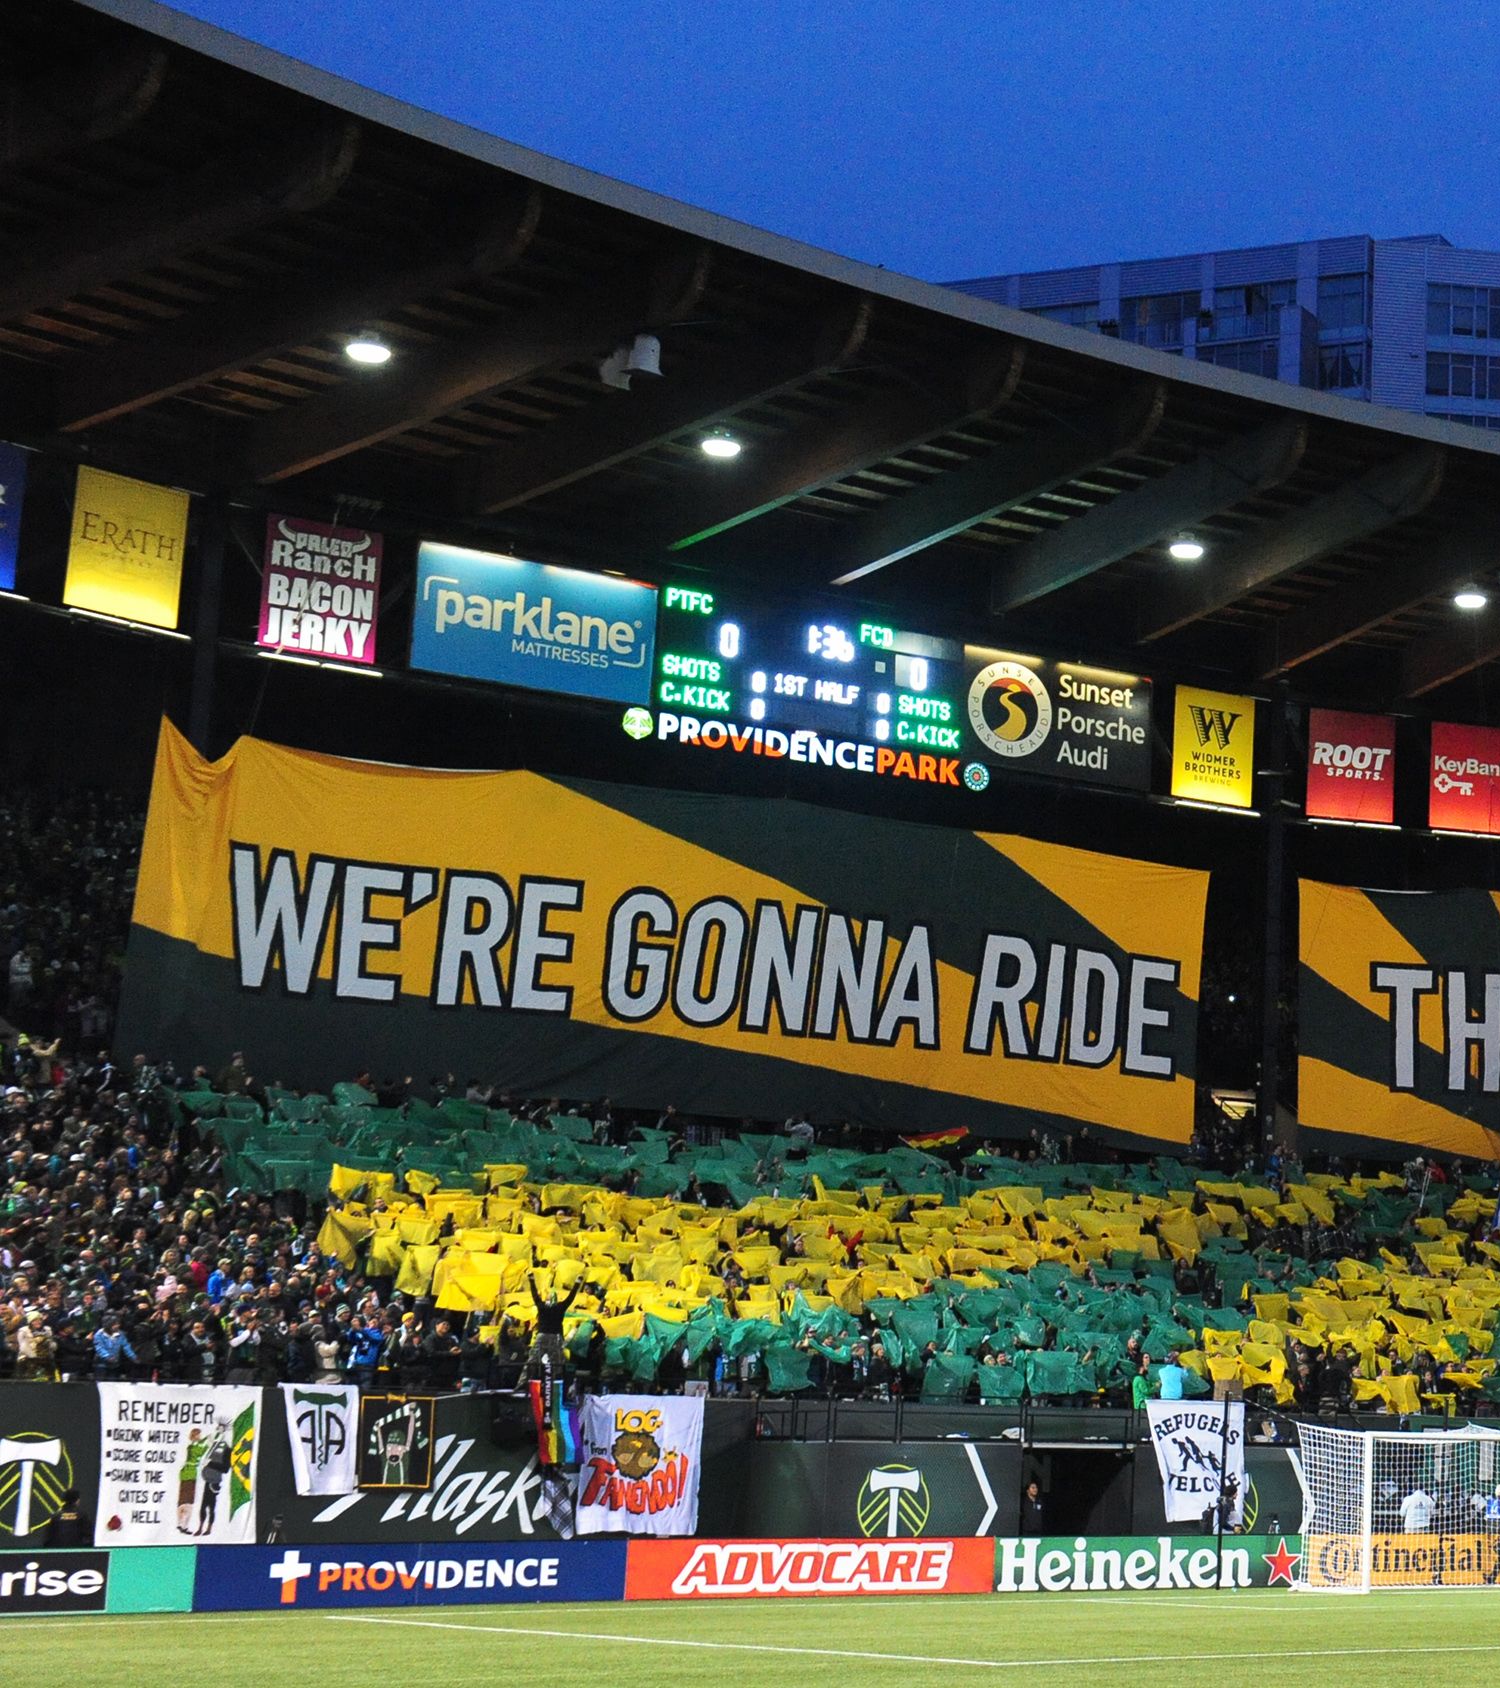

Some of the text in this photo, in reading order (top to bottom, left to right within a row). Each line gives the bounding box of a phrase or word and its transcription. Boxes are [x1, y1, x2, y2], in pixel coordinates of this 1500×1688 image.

[80, 511, 177, 561] ERATH
[267, 573, 374, 620] BACON
[665, 587, 714, 614] PTFC
[262, 607, 372, 658] JERKY
[435, 584, 636, 656] parklane
[718, 622, 741, 658] 0
[860, 623, 894, 648] FCD
[511, 639, 609, 669] MATTRESSES
[662, 654, 721, 682] SHOTS
[773, 672, 861, 705] 1ST HALF
[908, 657, 929, 692] 0
[1059, 674, 1134, 709] Sunset
[898, 695, 951, 721] SHOTS
[1056, 707, 1146, 745] Porsche
[1056, 740, 1109, 770] Audi
[1191, 751, 1236, 767] WIDMER
[1312, 742, 1392, 771] ROOT
[1184, 761, 1242, 780] BROTHERS
[1193, 775, 1232, 787] BREWING
[1326, 766, 1382, 781] SPORTS
[231, 843, 1180, 1078] WE'RE GONNA RIDE
[118, 1400, 216, 1424] REMEMBER
[112, 1428, 180, 1444] DRINK WATER
[111, 1450, 176, 1464] SCORE GOALS
[111, 1468, 164, 1483] SHAKE THE
[313, 1433, 577, 1535] lask
[1168, 1472, 1241, 1493] ELCE
[118, 1490, 166, 1504] GATES OF
[131, 1510, 161, 1524] HELL
[0, 1562, 104, 1597] rise
[318, 1557, 560, 1591] PROVIDENCE
[674, 1543, 952, 1592] ADVOCARE
[997, 1537, 1253, 1592] Heineken
